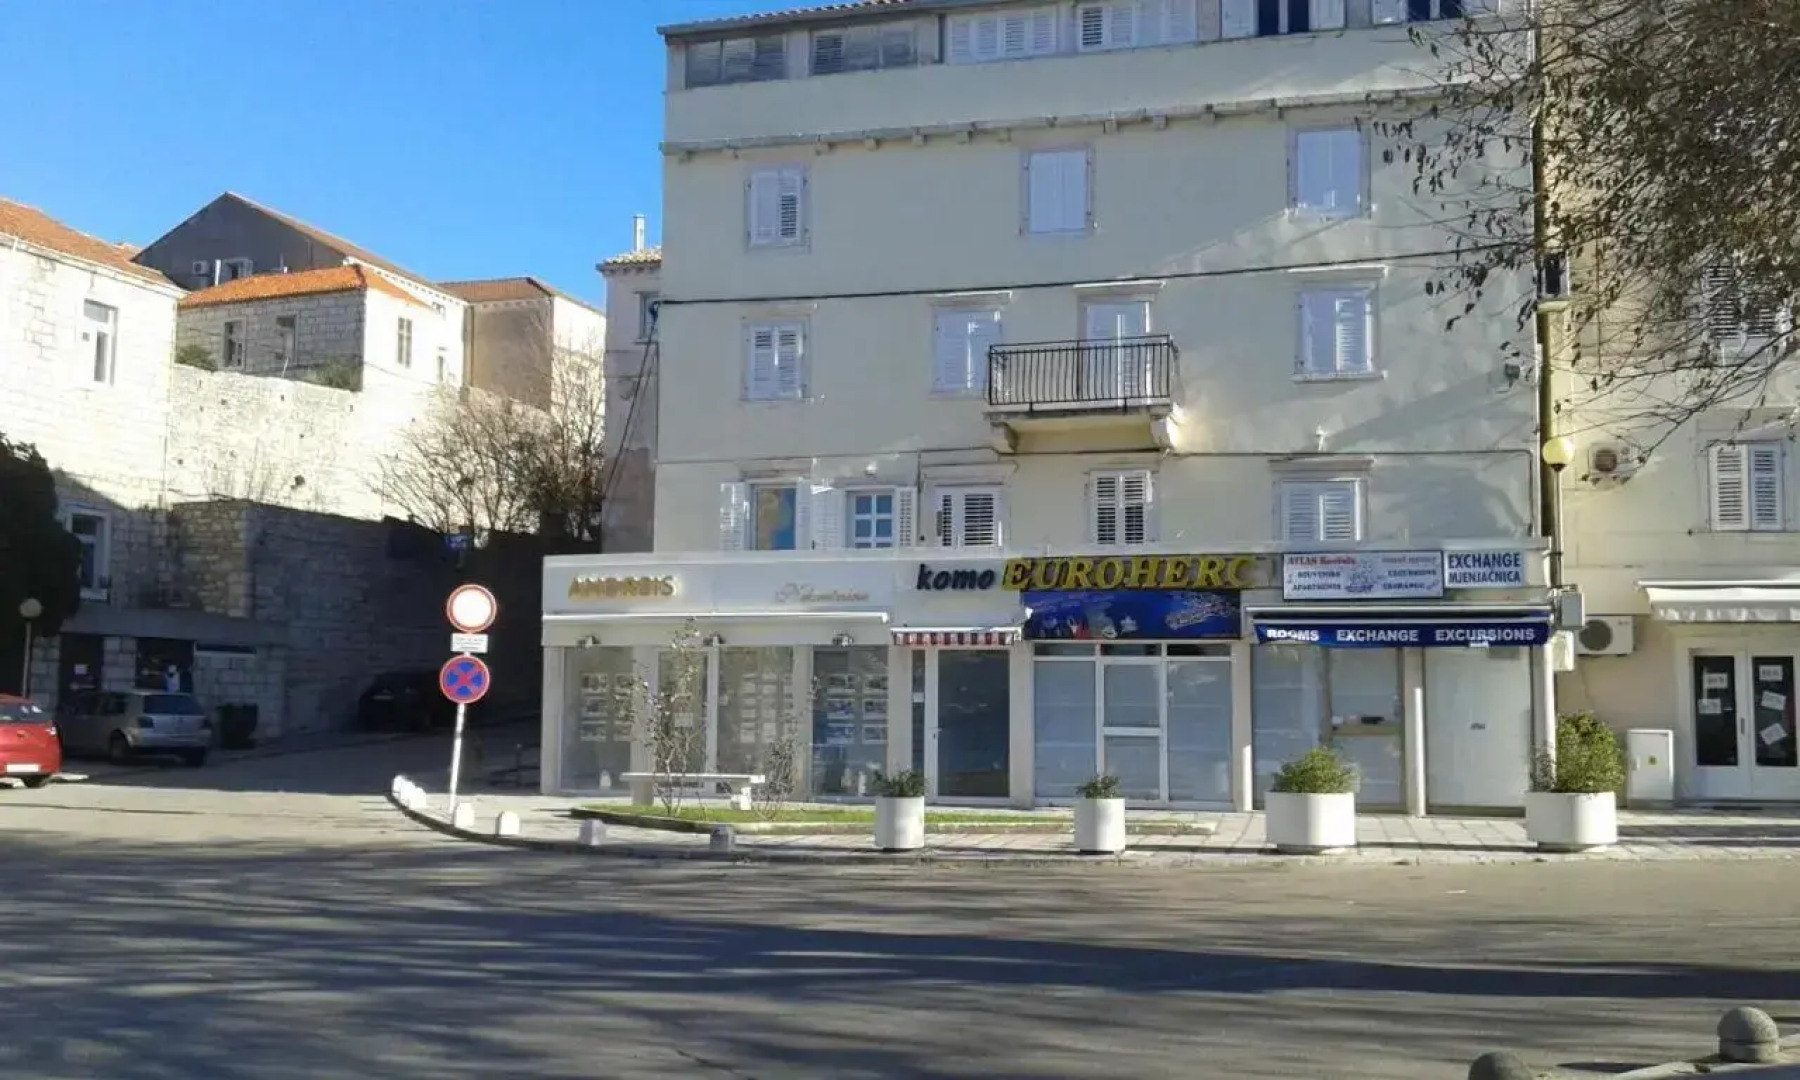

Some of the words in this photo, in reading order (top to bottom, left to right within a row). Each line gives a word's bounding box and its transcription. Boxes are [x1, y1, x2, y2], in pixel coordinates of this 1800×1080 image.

[1448, 553, 1520, 568] EXCHANGE
[916, 563, 996, 590] komo
[1003, 555, 1256, 591] EUROHERC
[1266, 629, 1319, 641] ROOMS
[1336, 629, 1419, 641] EXCHANGE
[1435, 628, 1535, 641] EXCURSIONS
